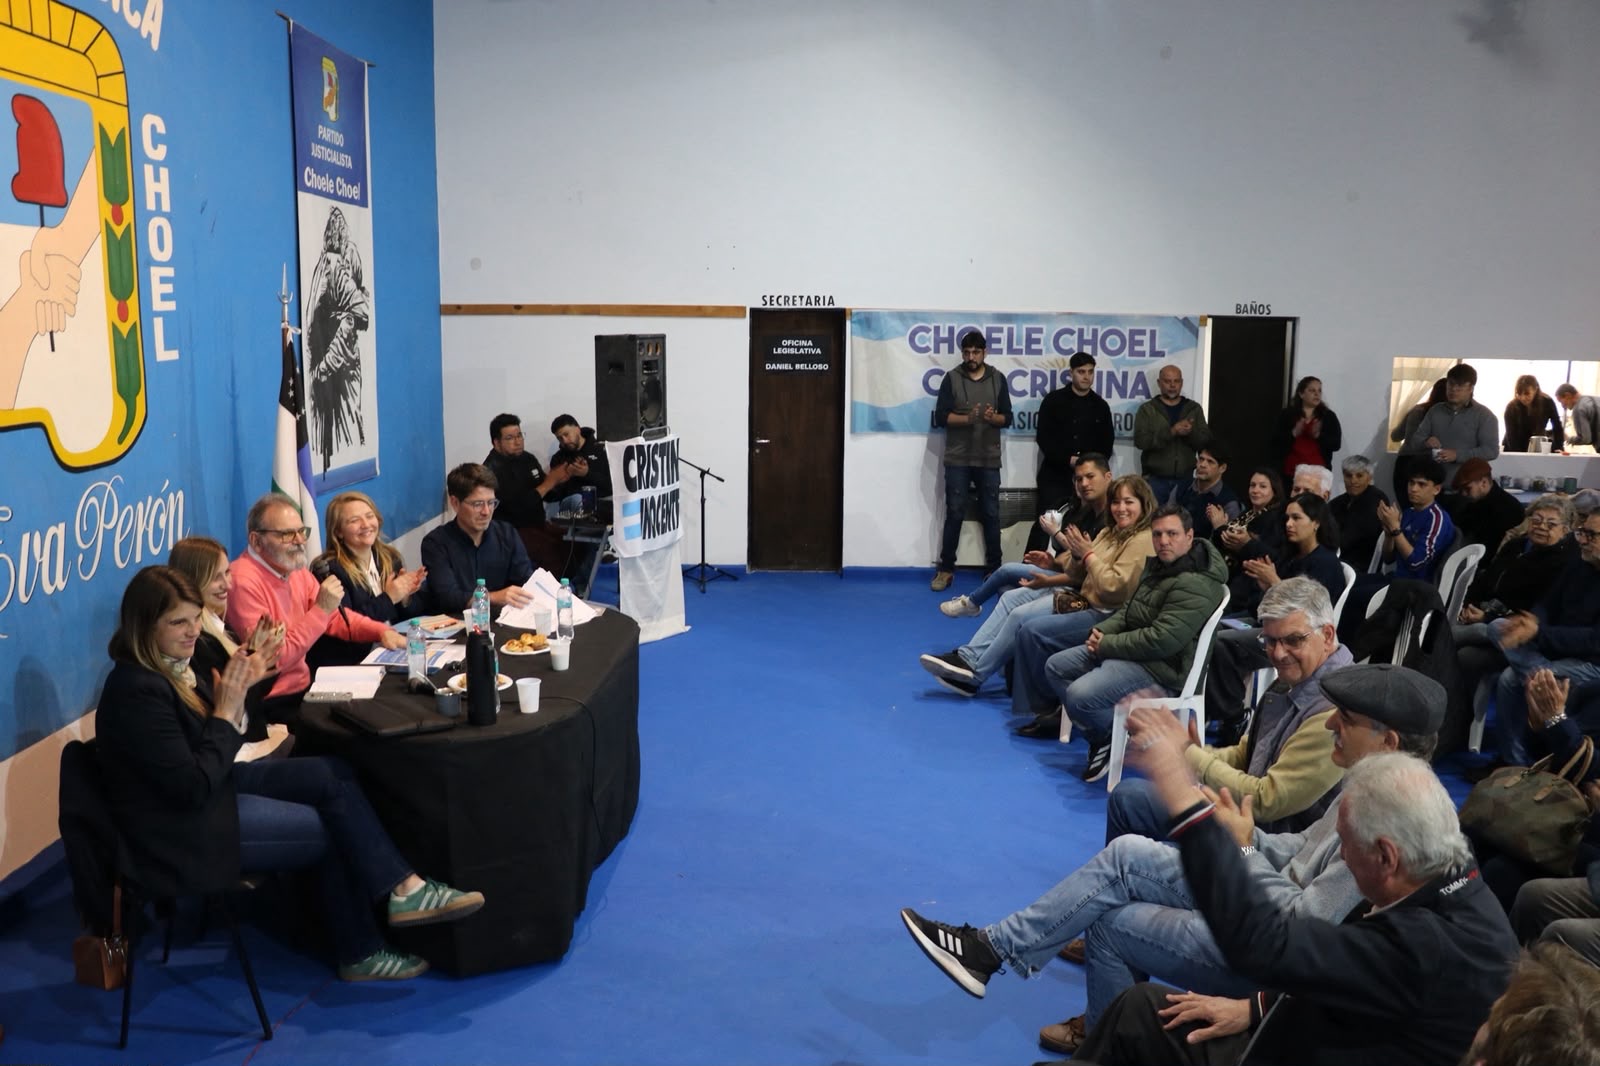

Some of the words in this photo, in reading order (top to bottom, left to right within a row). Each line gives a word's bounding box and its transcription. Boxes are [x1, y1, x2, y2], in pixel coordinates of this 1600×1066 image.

[318, 124, 344, 147] PARTIDO
[311, 143, 353, 169] JUSTICIALISTA
[304, 166, 334, 194] Choele
[335, 175, 360, 200] Choel
[141, 113, 179, 362] CHOEL
[762, 294, 835, 307] SECRETARIA
[1235, 300, 1272, 315] BAÑOS
[773, 347, 821, 355] LEGISLATIVA
[781, 339, 813, 347] OFICINA
[1052, 327, 1166, 358] CHOEL
[765, 363, 794, 371] DANIEL
[795, 363, 829, 371] BELLOSO
[1007, 368, 1152, 400] CRIINA
[623, 438, 680, 493] CRISTIN
[75, 475, 190, 582] Perón
